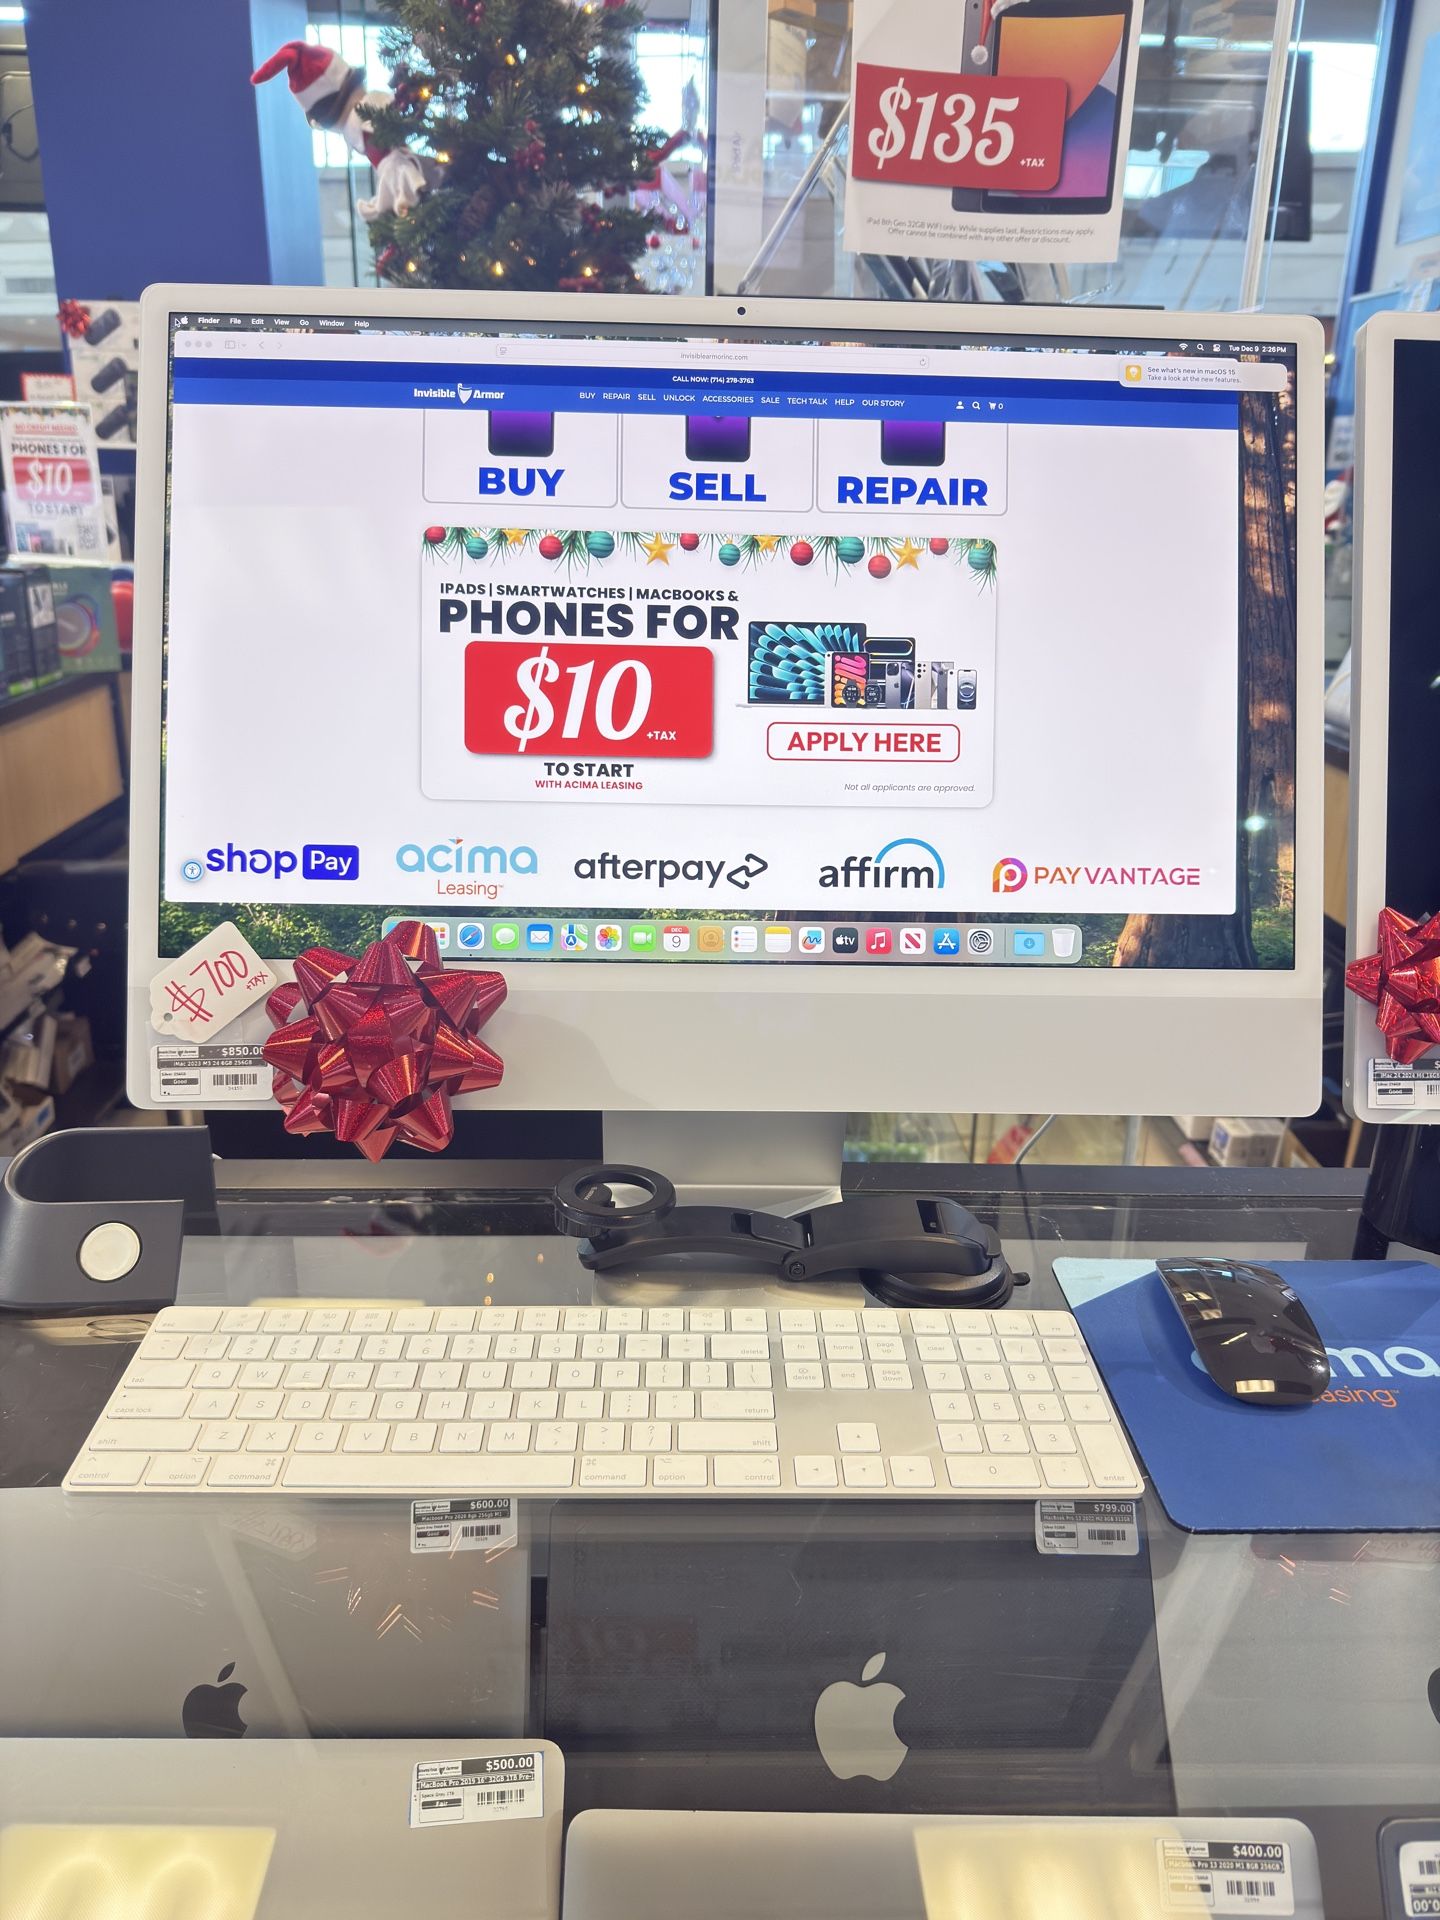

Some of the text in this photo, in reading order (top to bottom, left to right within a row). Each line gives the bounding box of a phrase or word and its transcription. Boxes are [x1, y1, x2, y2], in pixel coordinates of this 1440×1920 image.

[868, 78, 1019, 169] $135
[1020, 158, 1045, 167] +TAX
[710, 376, 724, 384] (714)
[413, 387, 505, 400] Invisible Armor
[27, 461, 73, 498] $10
[479, 467, 565, 498] BUY
[669, 472, 766, 502] SELL
[837, 476, 988, 506] REPAIR
[441, 583, 738, 601] IPADS SMARTWATCHES MACBOOKS &
[440, 599, 739, 640] PHONES FOR
[504, 646, 652, 752] $10
[647, 731, 676, 741] +TAX
[788, 732, 941, 752] APPLY HERE
[544, 762, 634, 778] TO START
[535, 780, 643, 790] WITH ACIMA LEASING
[844, 783, 858, 791] Not
[861, 783, 870, 791] all
[872, 784, 915, 793] applicants
[934, 784, 975, 794] approved.
[206, 842, 352, 879] shop Pay
[396, 838, 538, 874] acima
[574, 852, 726, 888] afterpay
[818, 856, 934, 888] affirm
[672, 936, 681, 948] 9
[845, 935, 855, 946] tv
[246, 972, 268, 990] +TAX
[752, 1439, 771, 1447] shift
[79, 1472, 109, 1480] control
[169, 1472, 196, 1481] option
[584, 1473, 626, 1481] command
[659, 1473, 685, 1482] option
[745, 1473, 775, 1481] control
[471, 1499, 508, 1510] $600.00
[1095, 1504, 1132, 1513] $799.00
[486, 1756, 533, 1772] $500.00
[421, 1780, 447, 1788] MacBook
[1233, 1845, 1281, 1858] $400.00
